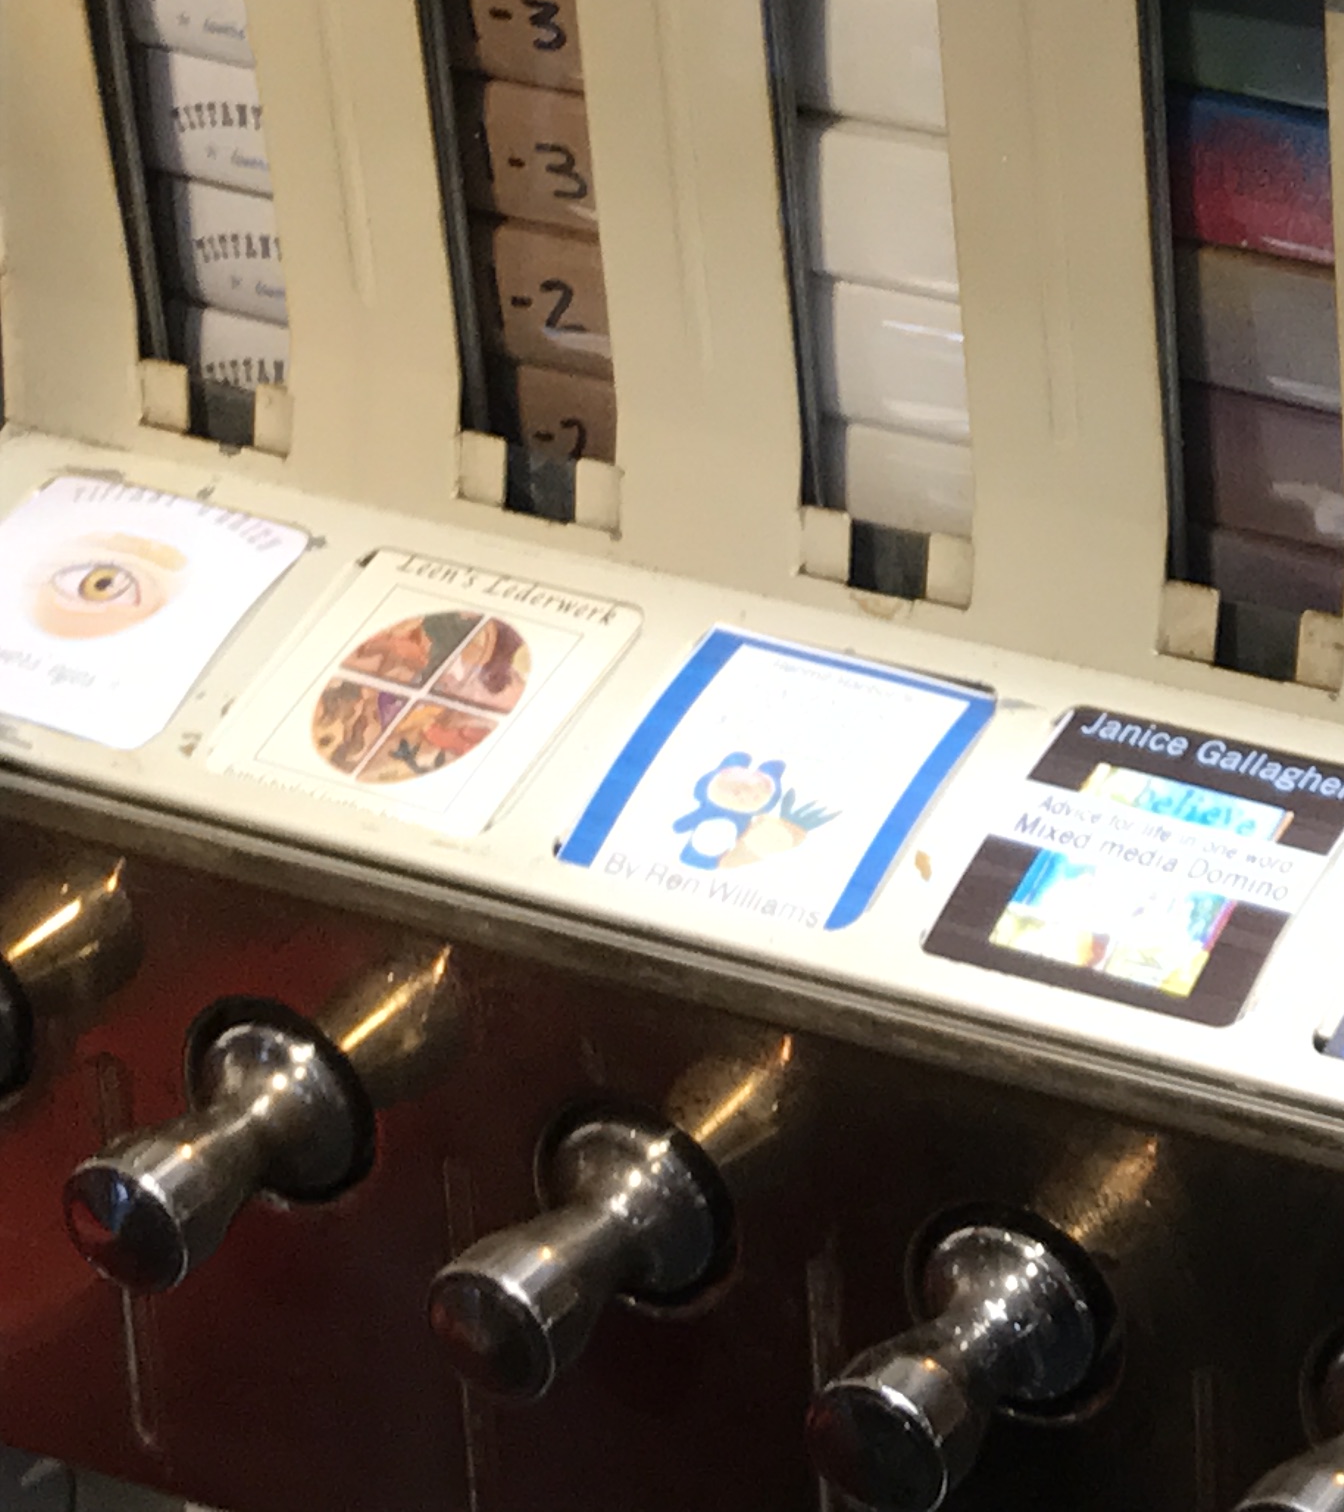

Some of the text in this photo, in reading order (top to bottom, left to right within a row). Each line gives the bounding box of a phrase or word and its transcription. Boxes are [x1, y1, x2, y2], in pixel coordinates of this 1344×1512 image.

[1080, 712, 1190, 756] Janice
[1014, 812, 1290, 903] Mixed media Domino
[708, 877, 820, 929] Williams
